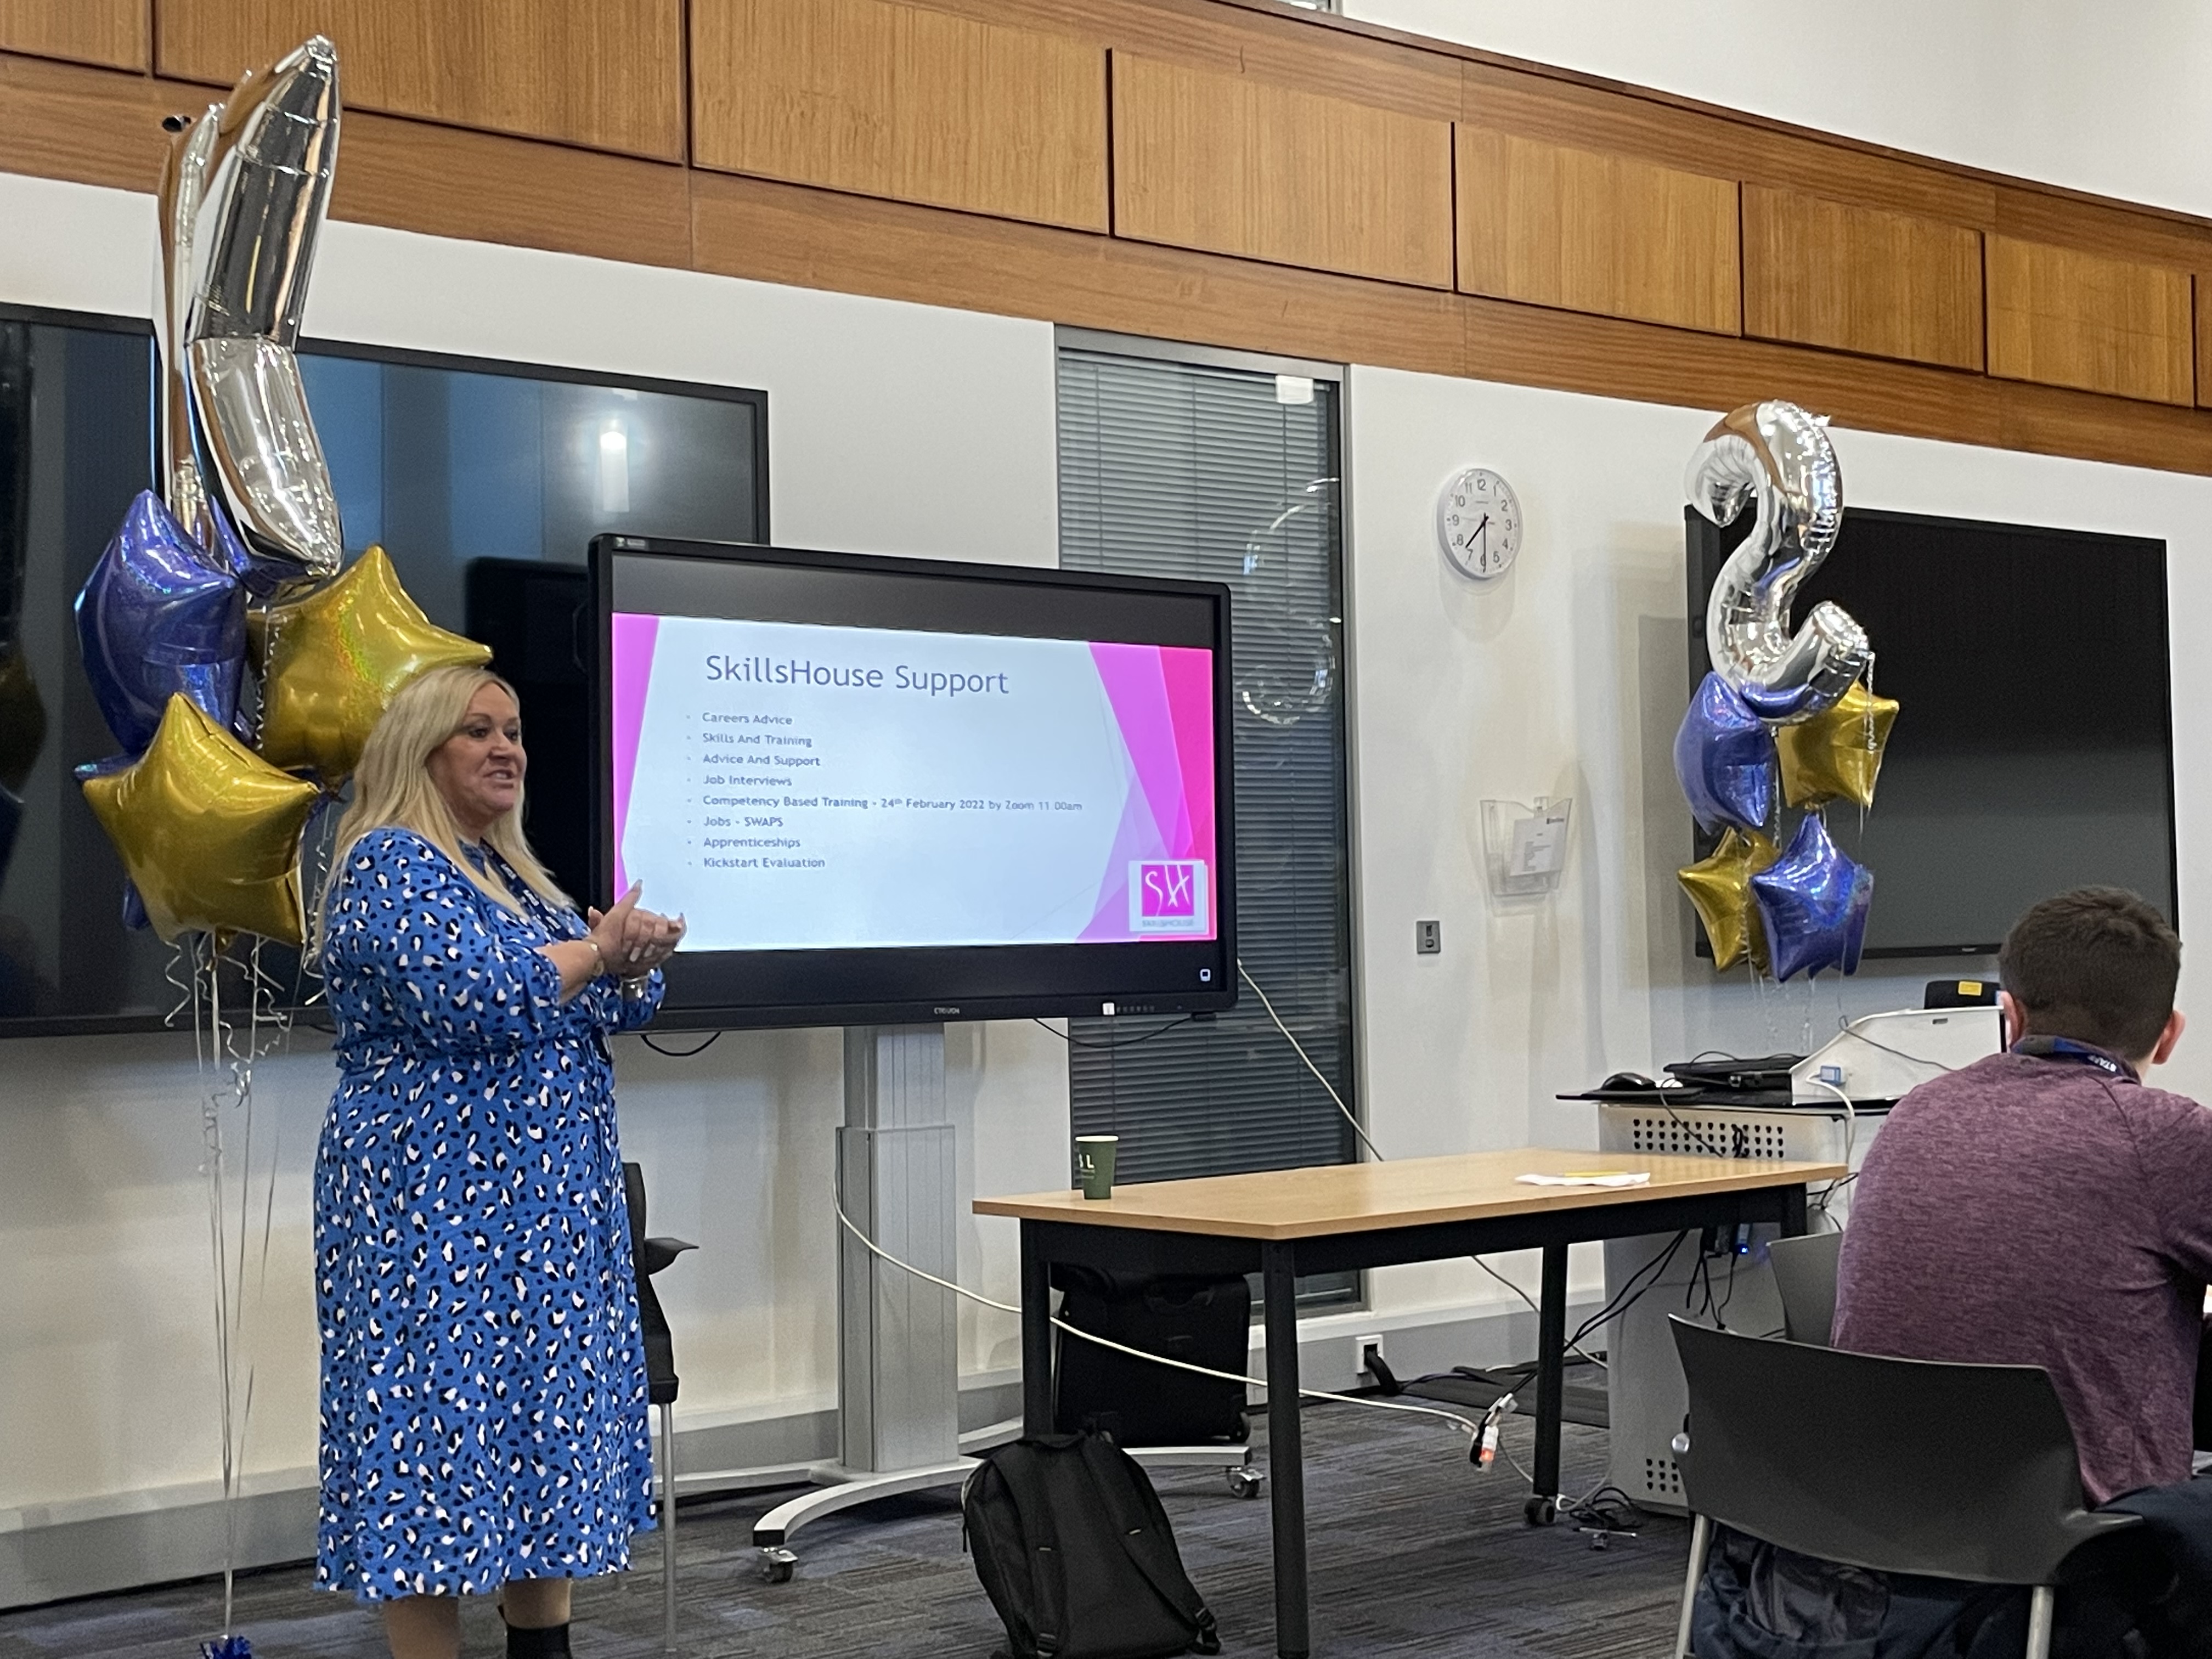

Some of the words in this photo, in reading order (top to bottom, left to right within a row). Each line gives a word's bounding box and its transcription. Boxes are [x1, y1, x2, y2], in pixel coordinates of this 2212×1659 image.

[1465, 482, 1472, 494] 11
[1477, 478, 1486, 491] 12
[1493, 484, 1497, 496] 1
[1455, 495, 1465, 507] 10
[1501, 499, 1508, 512] 2
[1452, 514, 1459, 526] 9
[1505, 519, 1512, 531] 3
[1457, 534, 1464, 546] 8
[1502, 538, 1508, 549] 4
[1467, 549, 1473, 561] 7
[707, 656, 883, 687] SkillsHouse
[896, 665, 1009, 697] Support
[702, 712, 749, 723] Careers
[753, 715, 792, 725] Advice
[703, 733, 734, 743] Skills
[737, 735, 760, 744] And
[764, 735, 812, 748] Training
[703, 754, 743, 764] Advice
[747, 755, 770, 764] And
[774, 755, 820, 767] Support
[703, 775, 725, 785] Job
[729, 775, 792, 786] Interviews
[703, 795, 780, 808] Competency
[784, 797, 817, 806] Based
[822, 797, 868, 809] Training
[906, 798, 955, 810] February
[960, 800, 984, 809] 2022
[989, 800, 1001, 810] by
[1006, 800, 1034, 810] Zoom
[704, 816, 731, 826] Jobs
[744, 817, 783, 827] SWAPS
[704, 838, 800, 849] Apprenticeships
[704, 857, 758, 868] Kickstart
[763, 857, 825, 868] Evaluation
